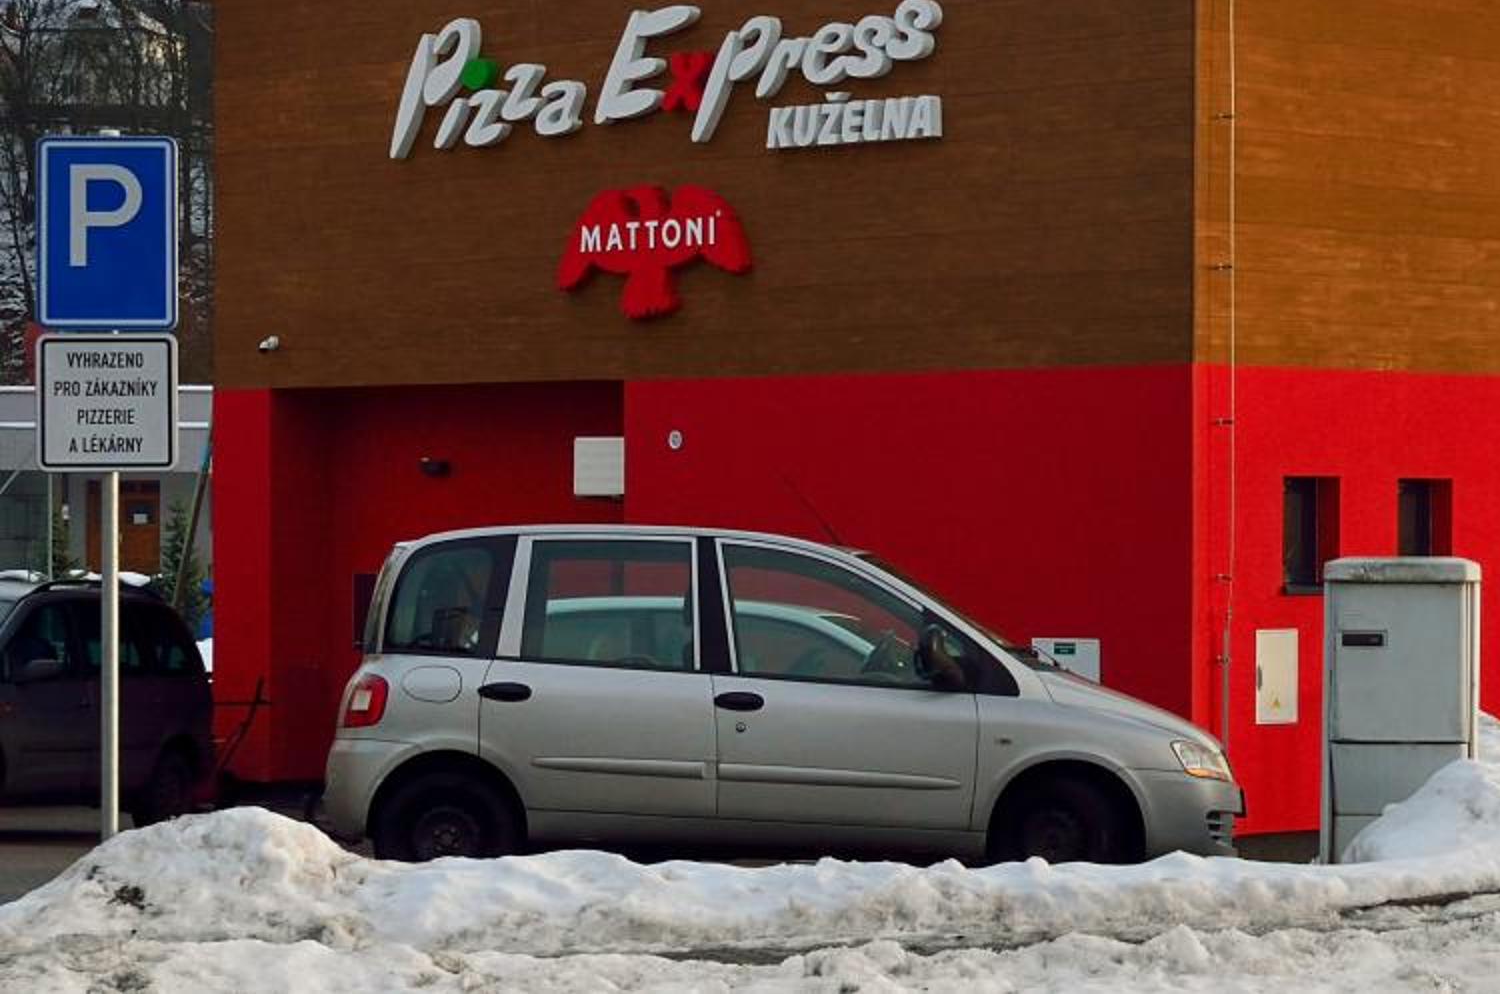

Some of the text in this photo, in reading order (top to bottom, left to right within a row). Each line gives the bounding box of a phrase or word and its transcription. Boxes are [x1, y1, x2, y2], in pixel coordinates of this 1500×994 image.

[390, 17, 587, 159] Pizza
[766, 91, 943, 149] KUŽELNA
[69, 163, 143, 267] P
[579, 214, 716, 254] MATTONI
[67, 351, 144, 369] VYHRAZENO
[53, 376, 158, 397] PRO ZÁKAZNÍKY
[77, 409, 136, 425] PIZZERIE
[69, 433, 143, 454] A LÉKÁRNY
